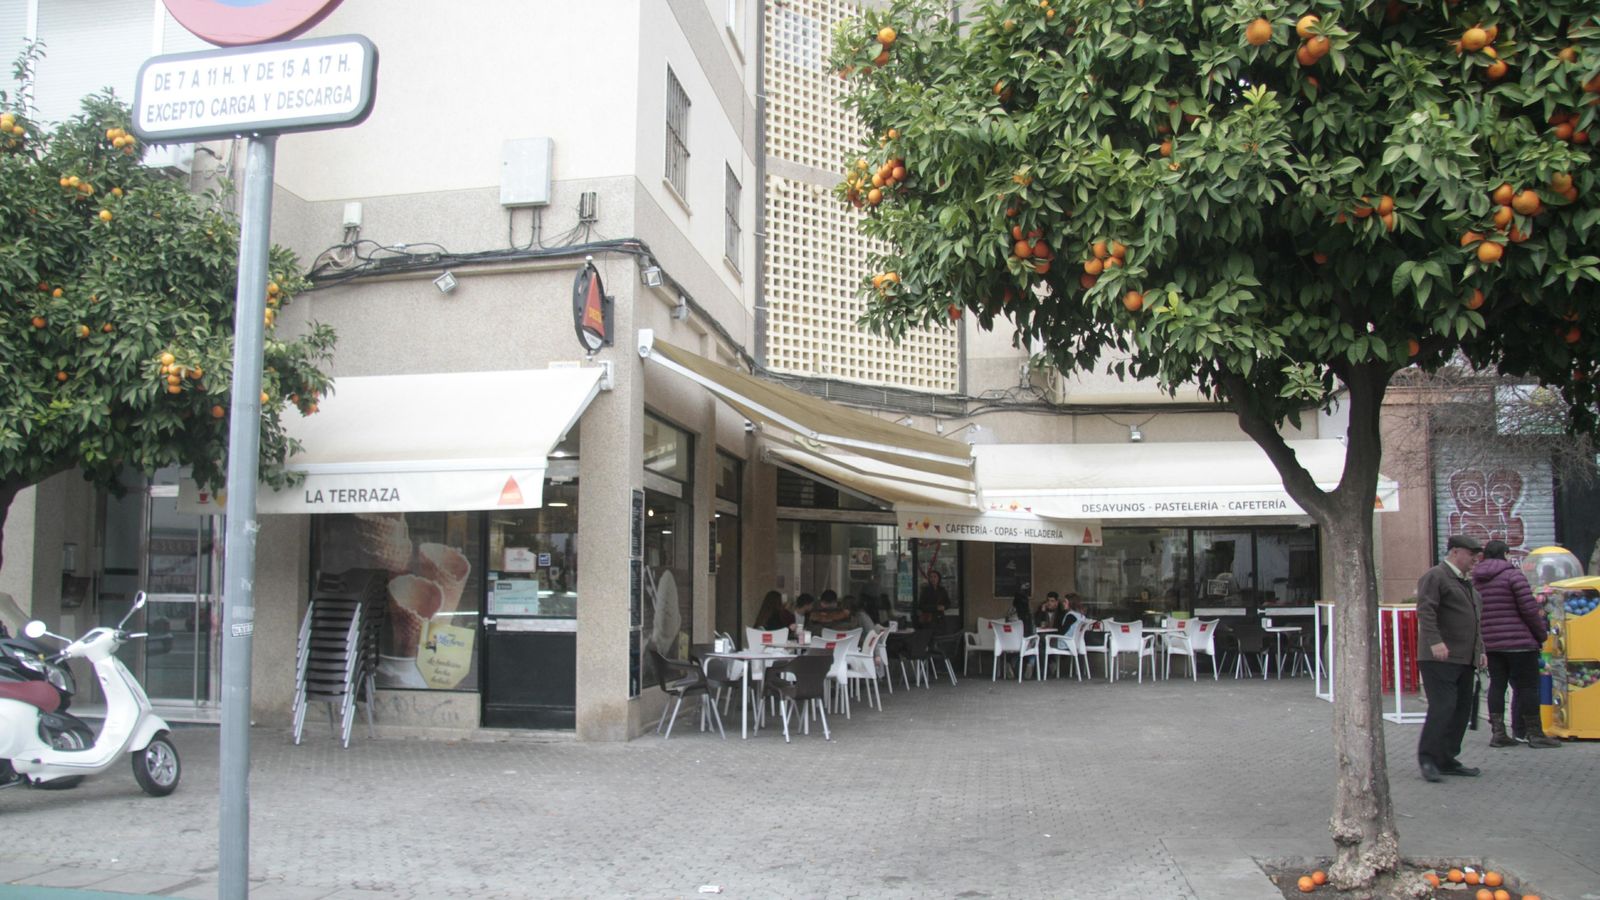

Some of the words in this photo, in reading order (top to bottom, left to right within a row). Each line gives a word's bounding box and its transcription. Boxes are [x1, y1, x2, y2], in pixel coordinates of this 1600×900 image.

[154, 72, 171, 92] DE
[178, 71, 186, 90] 7
[191, 69, 200, 88] A
[207, 67, 217, 86] 11
[222, 65, 235, 85] H.
[241, 64, 250, 83] Y
[257, 61, 274, 81] DE
[281, 59, 294, 79] 15
[302, 57, 310, 77] A
[318, 55, 332, 75] 17
[337, 53, 350, 73] H.
[147, 97, 205, 124] EXCEPTO
[210, 94, 256, 117] CARGA
[263, 92, 272, 112] Y
[277, 84, 352, 111] DESCARGA
[305, 489, 324, 504] LA
[329, 487, 400, 503] TERRAZA
[1081, 501, 1145, 513] DESAYUNOS
[1154, 499, 1219, 512] PASTELERÍA
[1228, 498, 1287, 511] CAFETERÍA
[945, 523, 987, 535] CAFETERÍA
[994, 527, 1018, 537] COPAS
[1024, 528, 1063, 539] HELADERÍA
